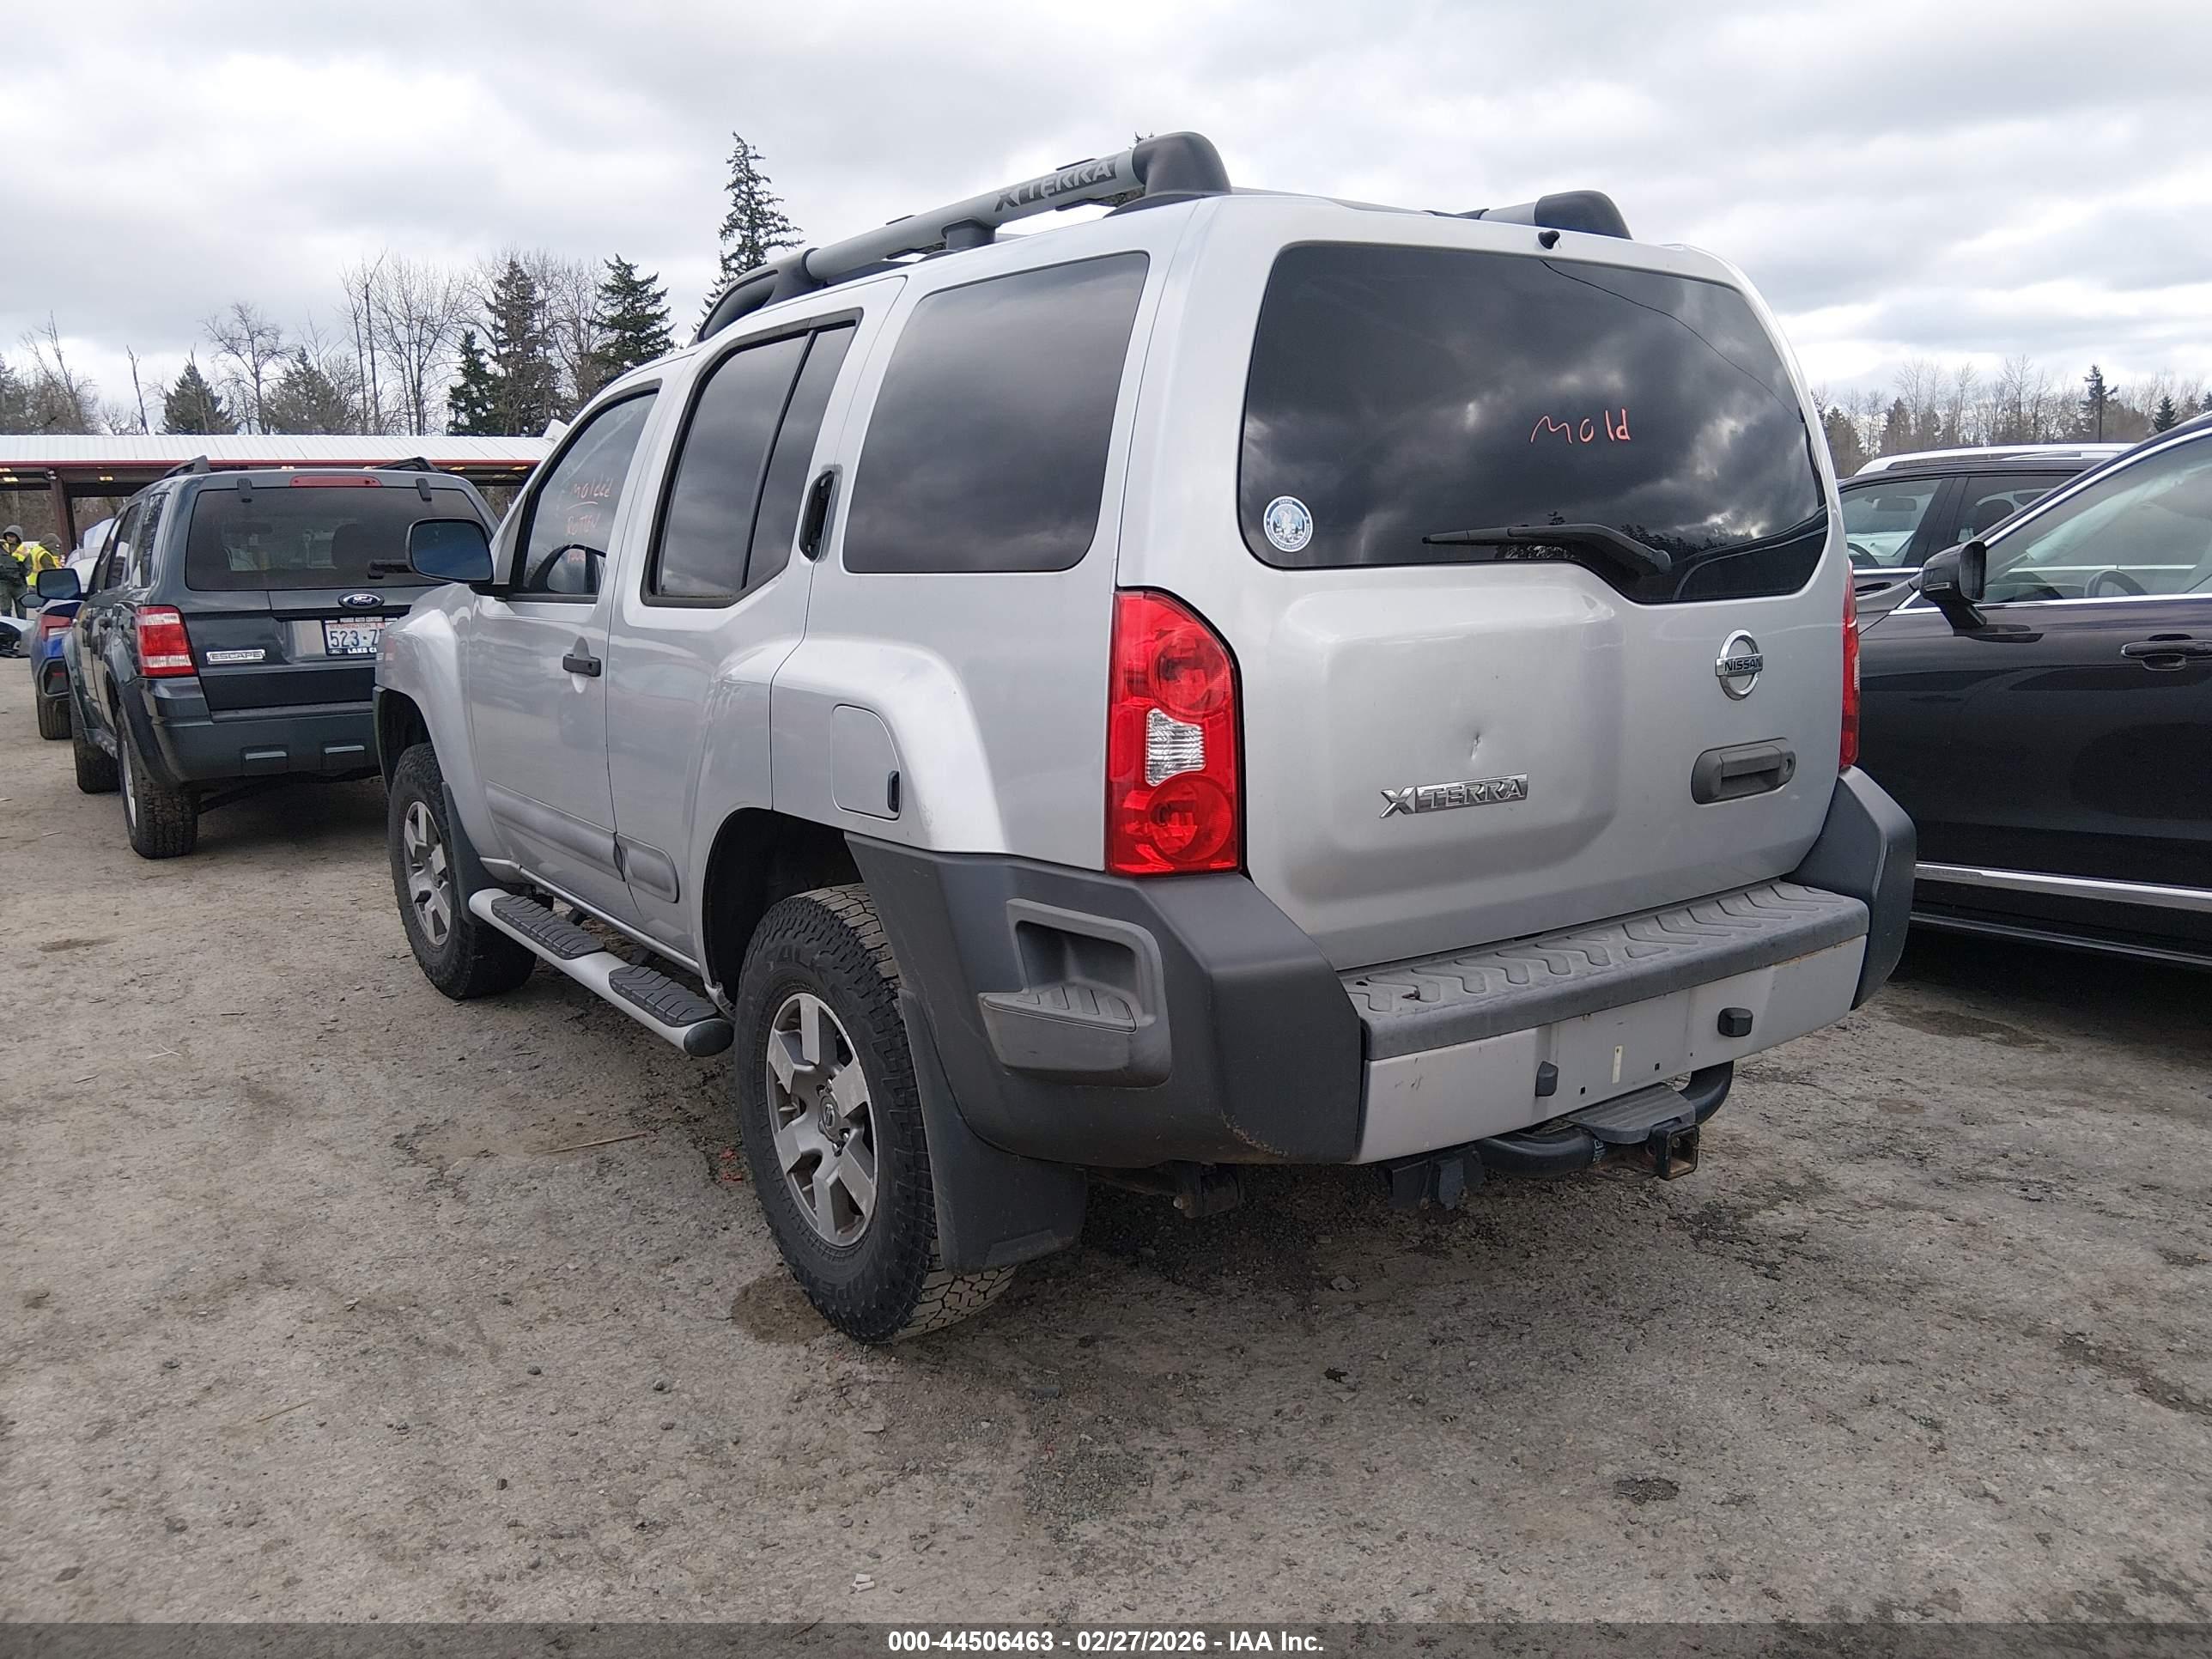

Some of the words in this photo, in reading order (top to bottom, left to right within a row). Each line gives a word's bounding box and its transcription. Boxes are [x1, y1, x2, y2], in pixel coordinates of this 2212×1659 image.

[994, 158, 1117, 213] XTERRA
[1529, 407, 1632, 445] Mold
[211, 650, 262, 660] ESCAPE
[1724, 657, 1761, 672] NISSAN
[1380, 773, 1528, 818] XTERRA
